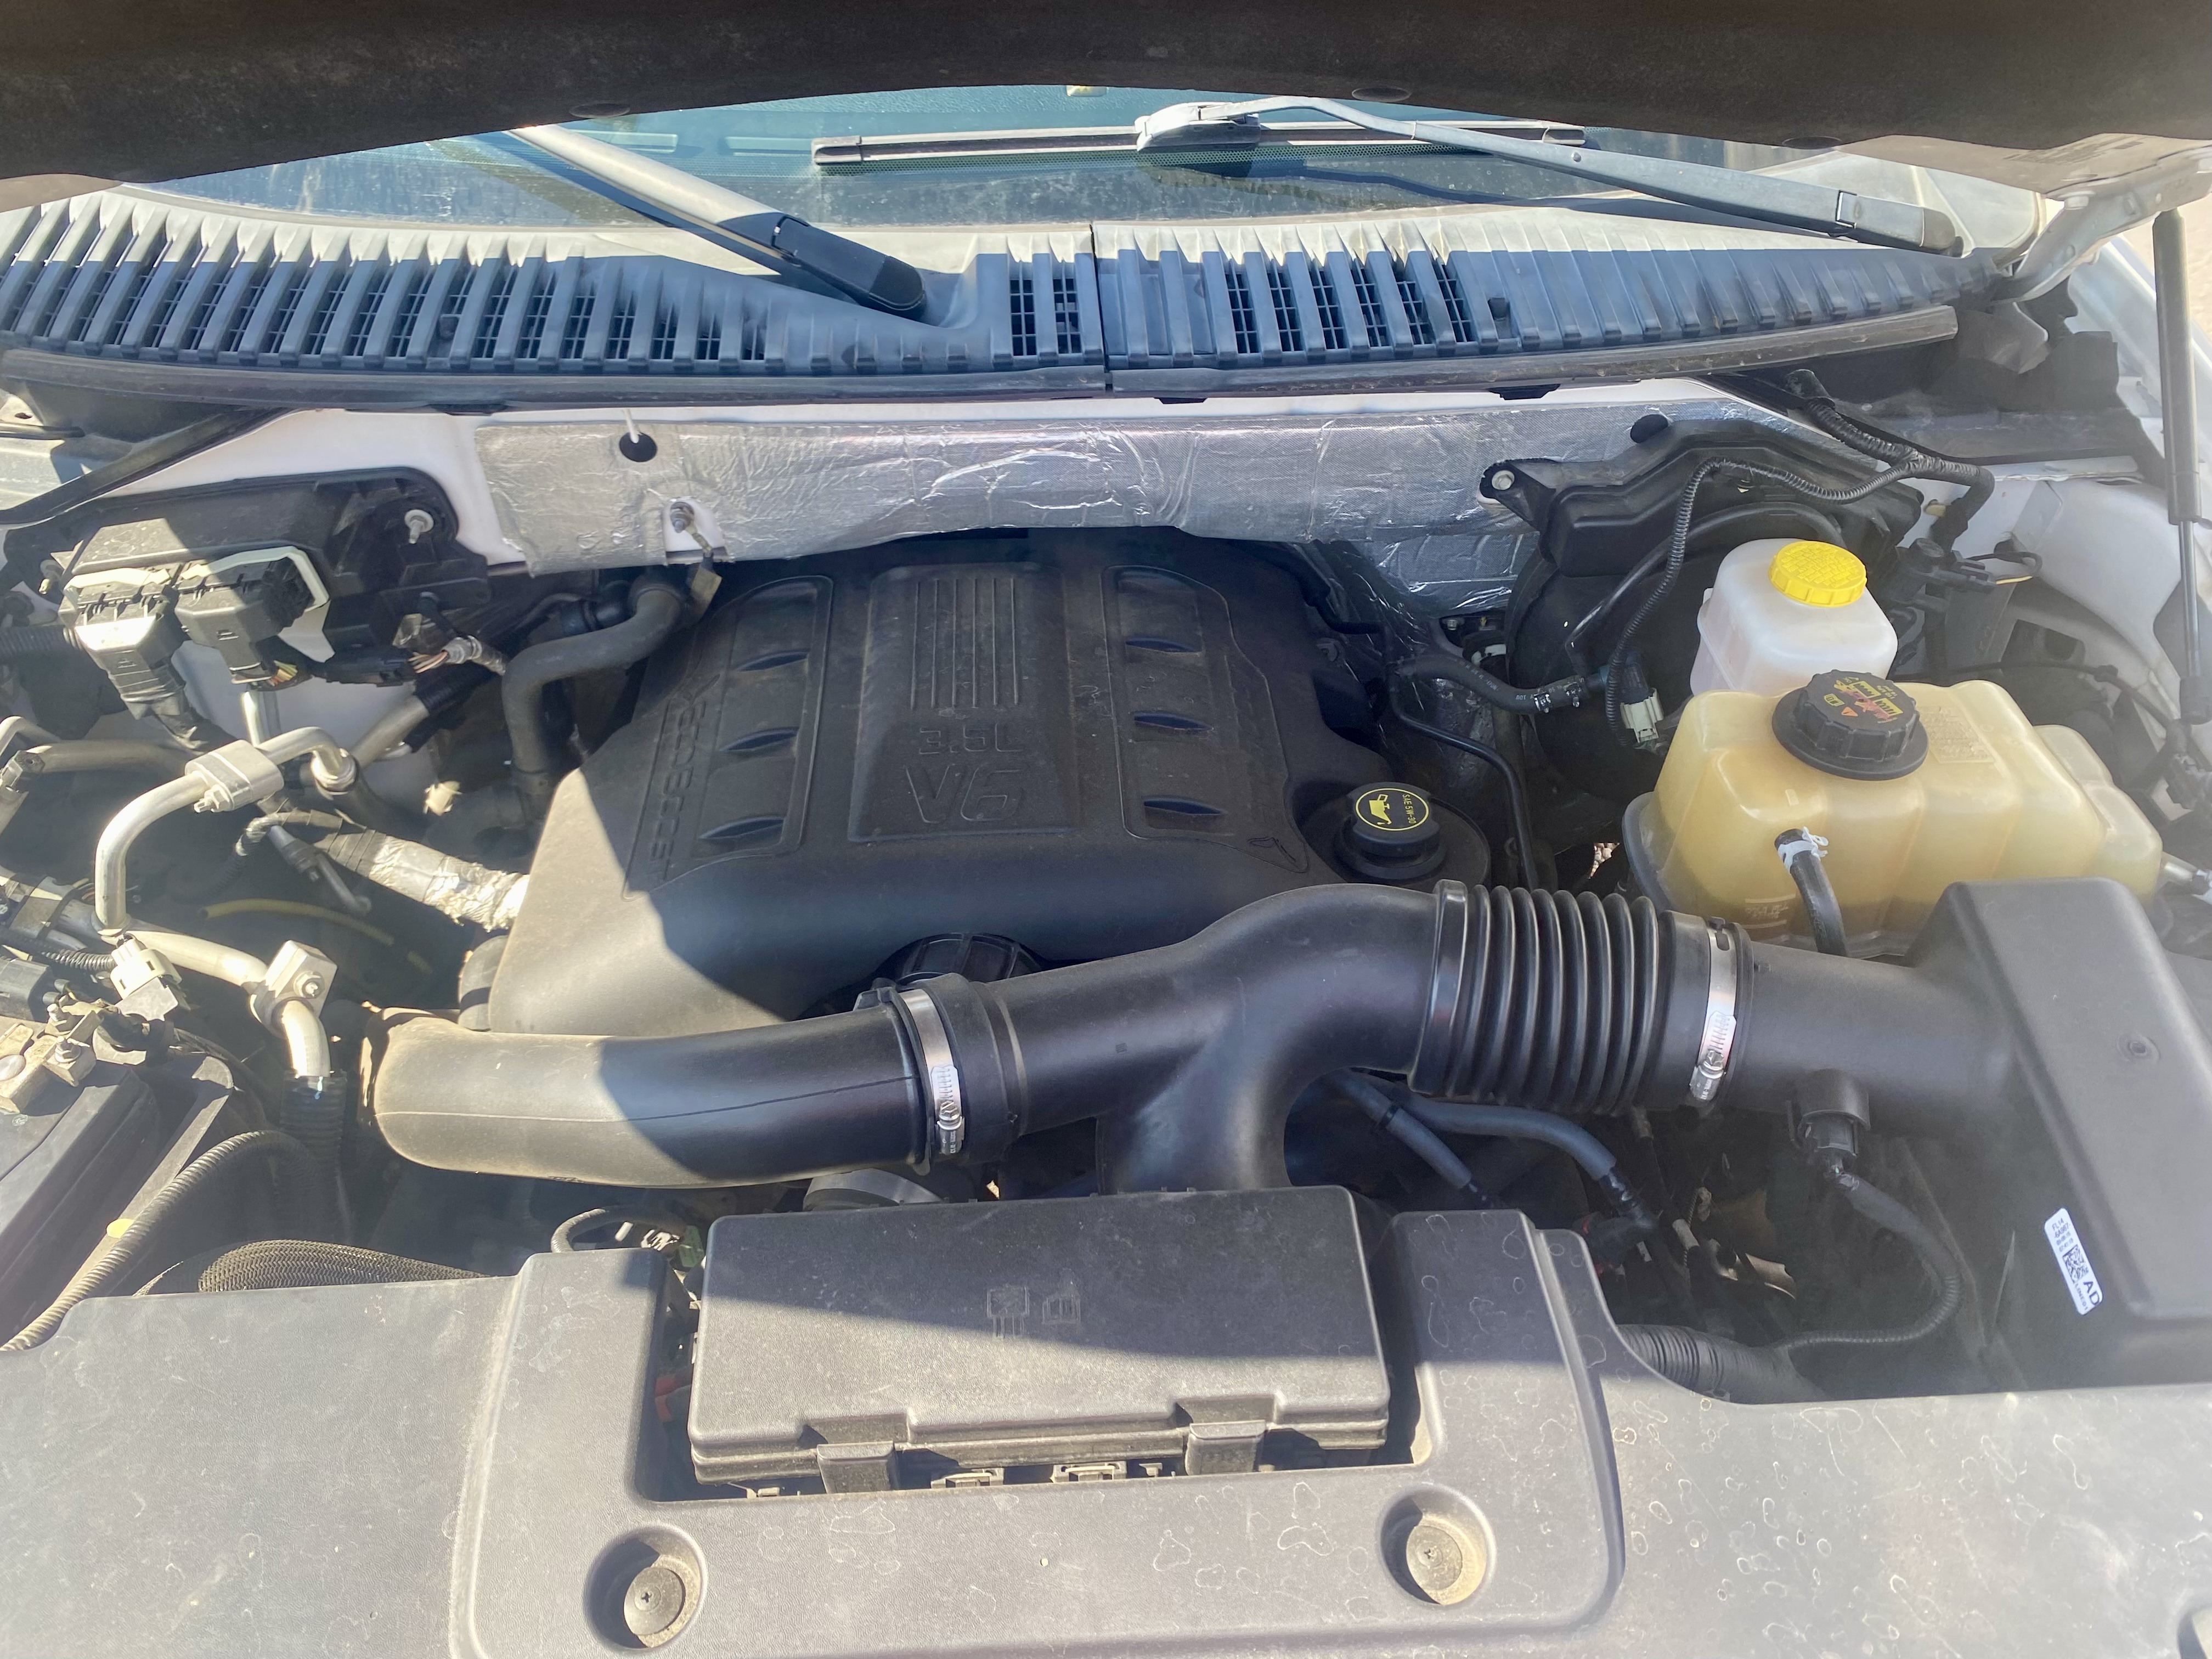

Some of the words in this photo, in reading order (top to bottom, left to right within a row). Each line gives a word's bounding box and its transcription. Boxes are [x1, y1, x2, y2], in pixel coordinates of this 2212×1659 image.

[902, 763, 1025, 824] V6
[1402, 794, 1412, 805] SAE
[1405, 805, 1417, 823] 5W-30
[2083, 1281, 2100, 1305] AD
